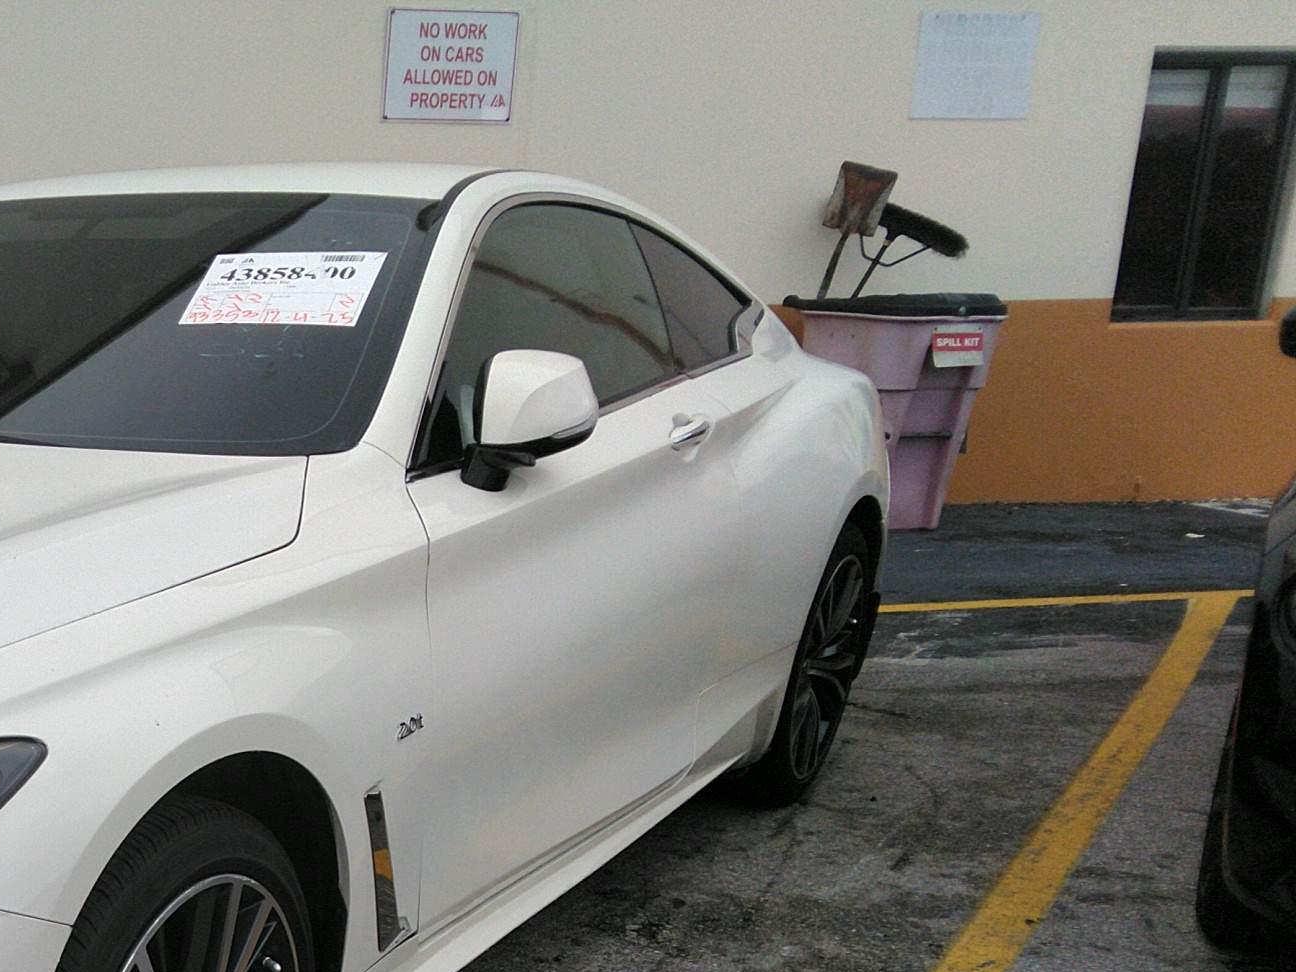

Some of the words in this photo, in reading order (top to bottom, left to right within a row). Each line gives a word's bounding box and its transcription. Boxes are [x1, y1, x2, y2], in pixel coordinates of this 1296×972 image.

[419, 22, 440, 38] NO
[445, 23, 488, 39] WORK
[420, 45, 440, 62] ON
[445, 46, 484, 63] CARS
[403, 69, 473, 86] ALLOWED
[477, 70, 497, 86] ON
[410, 92, 485, 109] PROPERTY
[936, 337, 962, 347] SPILL
[964, 337, 980, 346] KIT
